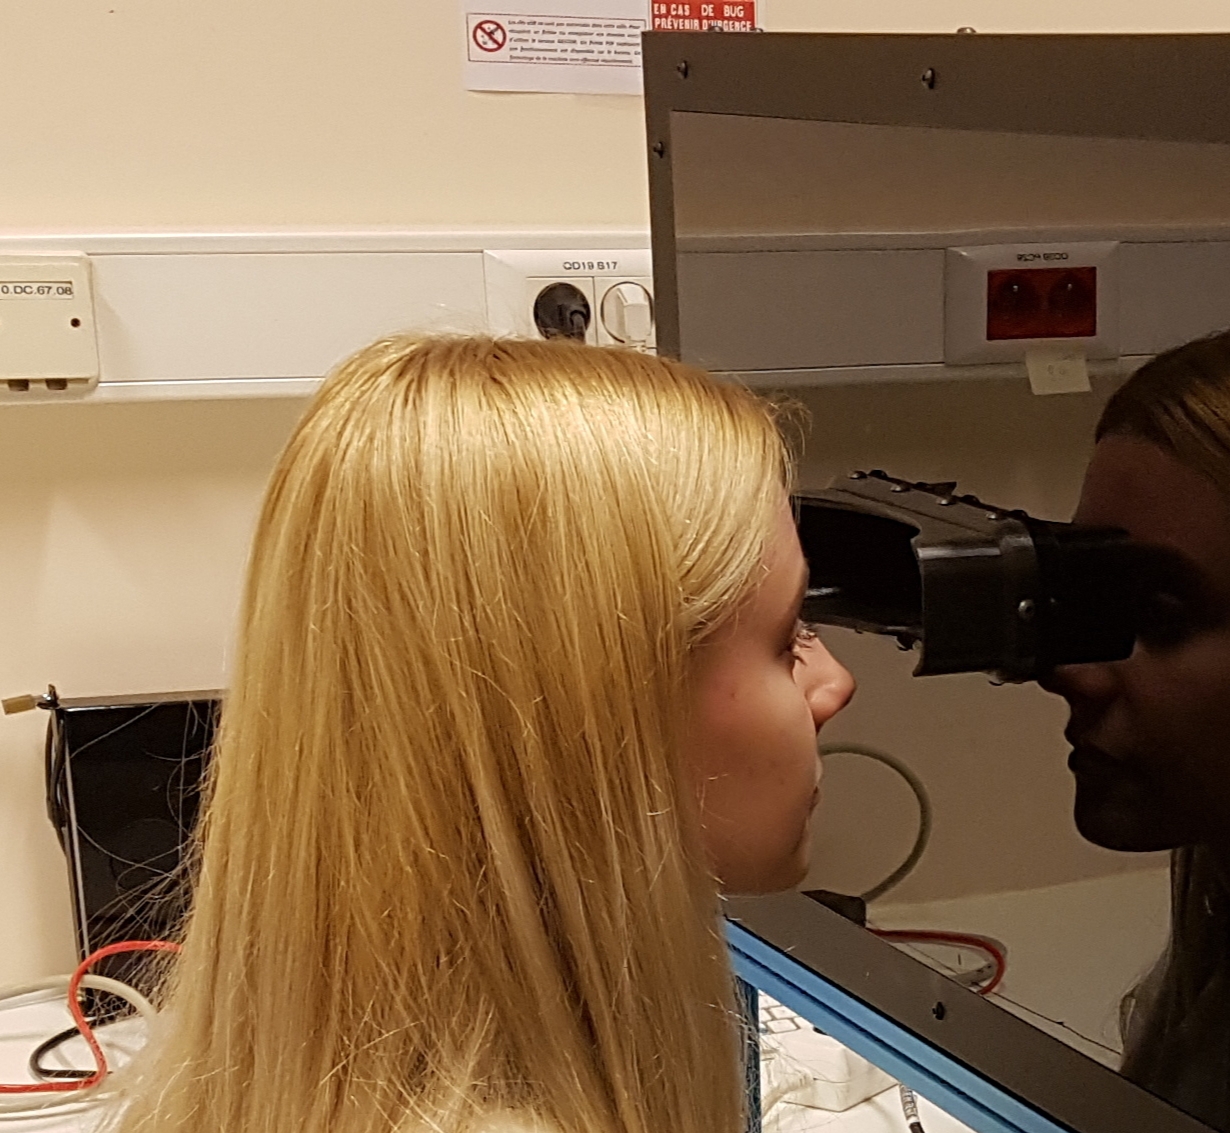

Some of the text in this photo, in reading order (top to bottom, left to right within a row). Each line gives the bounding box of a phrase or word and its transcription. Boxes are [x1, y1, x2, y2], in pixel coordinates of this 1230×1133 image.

[653, 3, 745, 18] EN CAS DE BUG
[654, 16, 700, 30] PRÉVENIR
